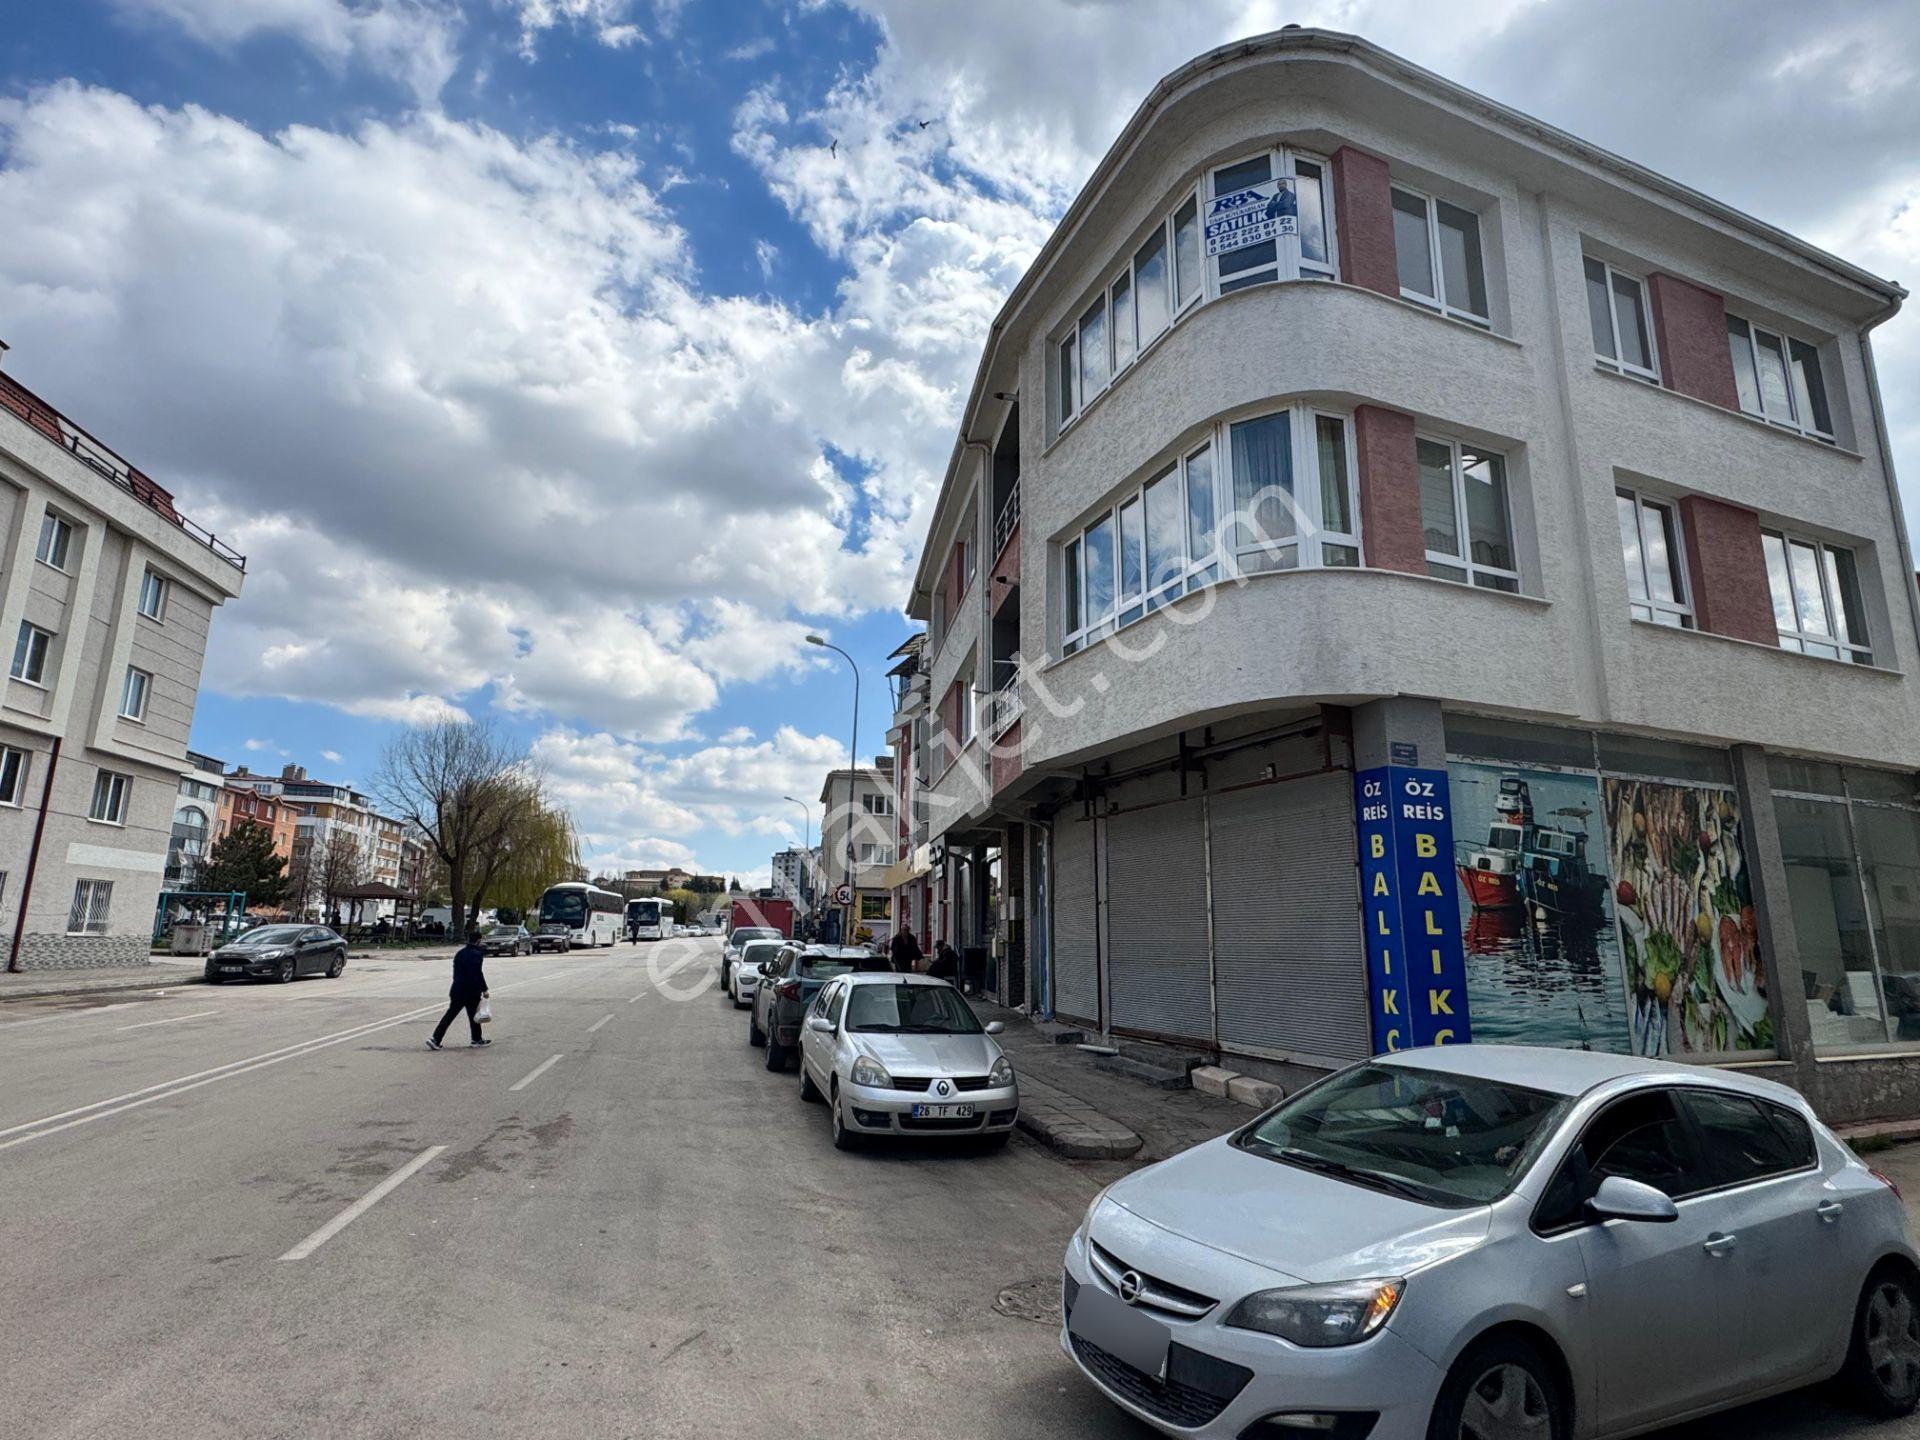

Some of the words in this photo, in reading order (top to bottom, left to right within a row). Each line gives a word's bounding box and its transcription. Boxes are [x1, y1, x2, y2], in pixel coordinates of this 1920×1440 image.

[1209, 208, 1269, 238] SATILIK
[1220, 232, 1238, 242] 222
[1242, 226, 1260, 236] 222
[1280, 217, 1292, 225] 22
[1220, 241, 1239, 250] 544
[1282, 225, 1294, 233] 30
[1364, 780, 1382, 798] ÖZ
[1405, 777, 1435, 796] ÖZ
[1363, 801, 1388, 821] REİS
[1403, 802, 1444, 821] REİS
[919, 1106, 930, 1117] 26
[938, 1106, 949, 1117] TF
[956, 1106, 972, 1117] 429
